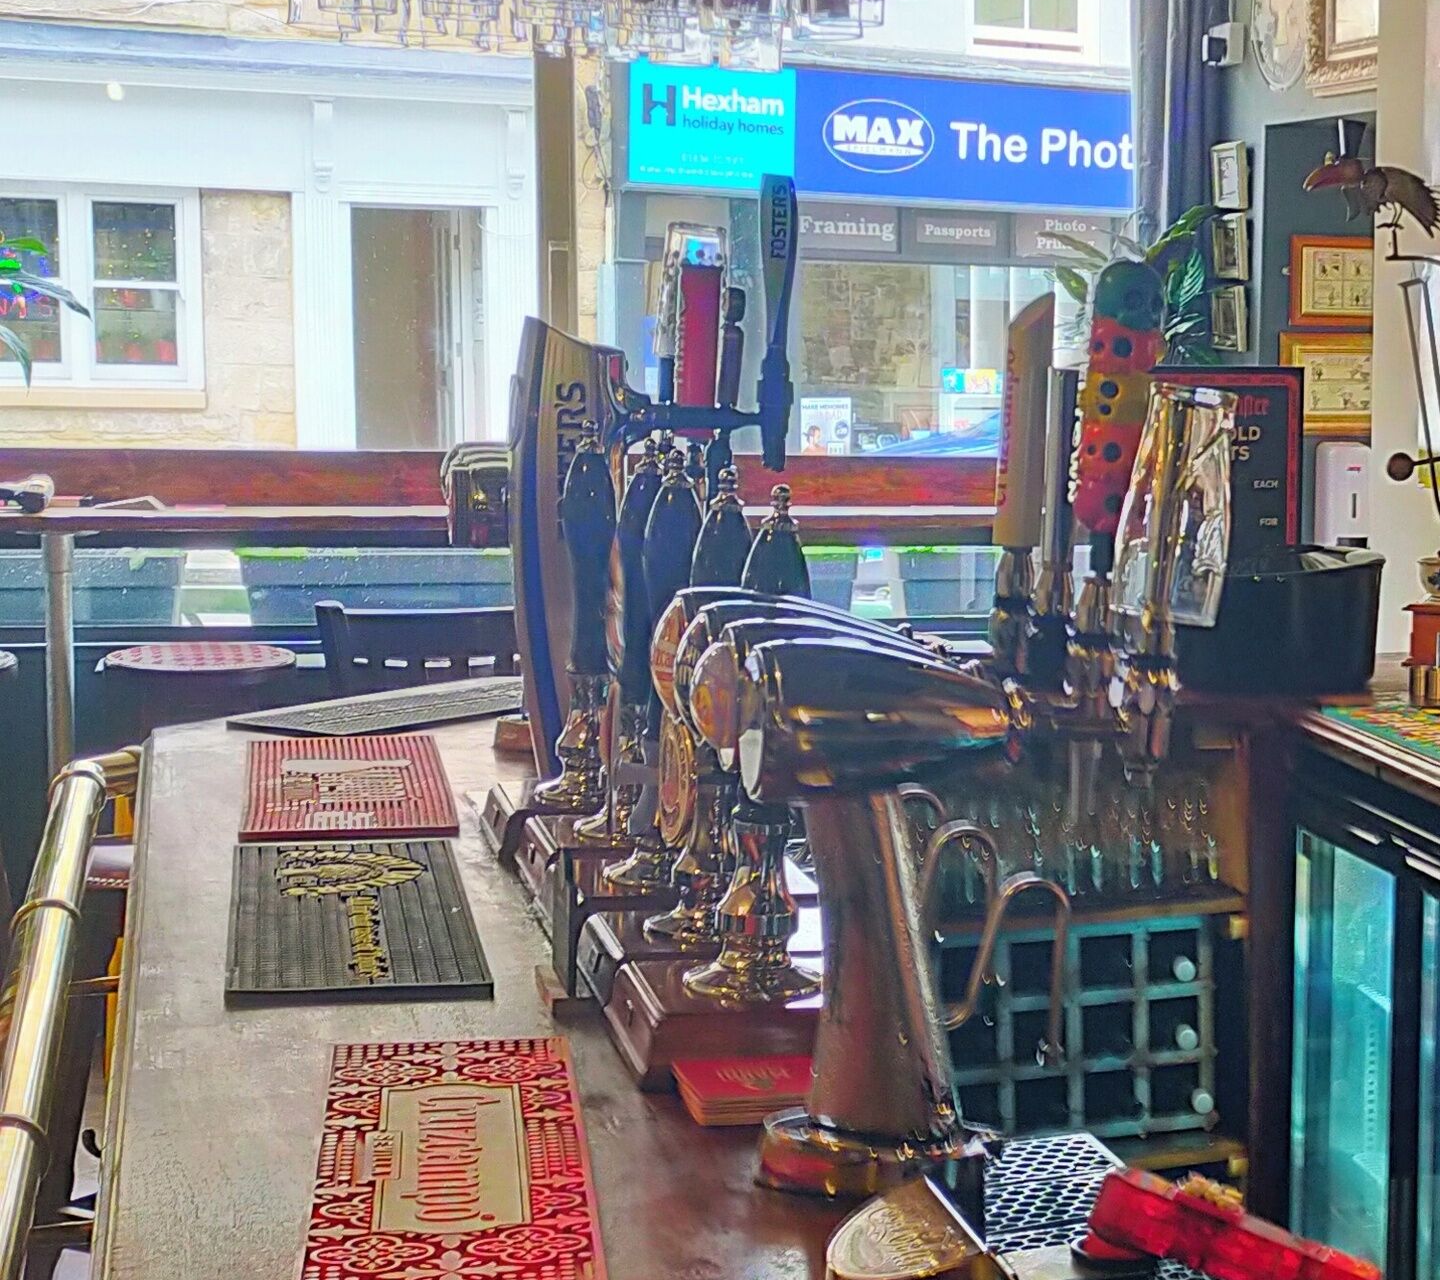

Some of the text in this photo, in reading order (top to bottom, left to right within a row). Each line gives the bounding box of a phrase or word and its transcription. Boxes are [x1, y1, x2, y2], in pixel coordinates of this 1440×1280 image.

[682, 85, 785, 116] Hexham
[682, 114, 785, 136] holiday homes
[832, 114, 1135, 170] MAX The Phot
[800, 214, 895, 242] Framing
[924, 223, 991, 240] Passports
[1044, 219, 1087, 233] Photo
[1253, 479, 1279, 489] EACH
[401, 1095, 501, 1224] Cruzcampo
